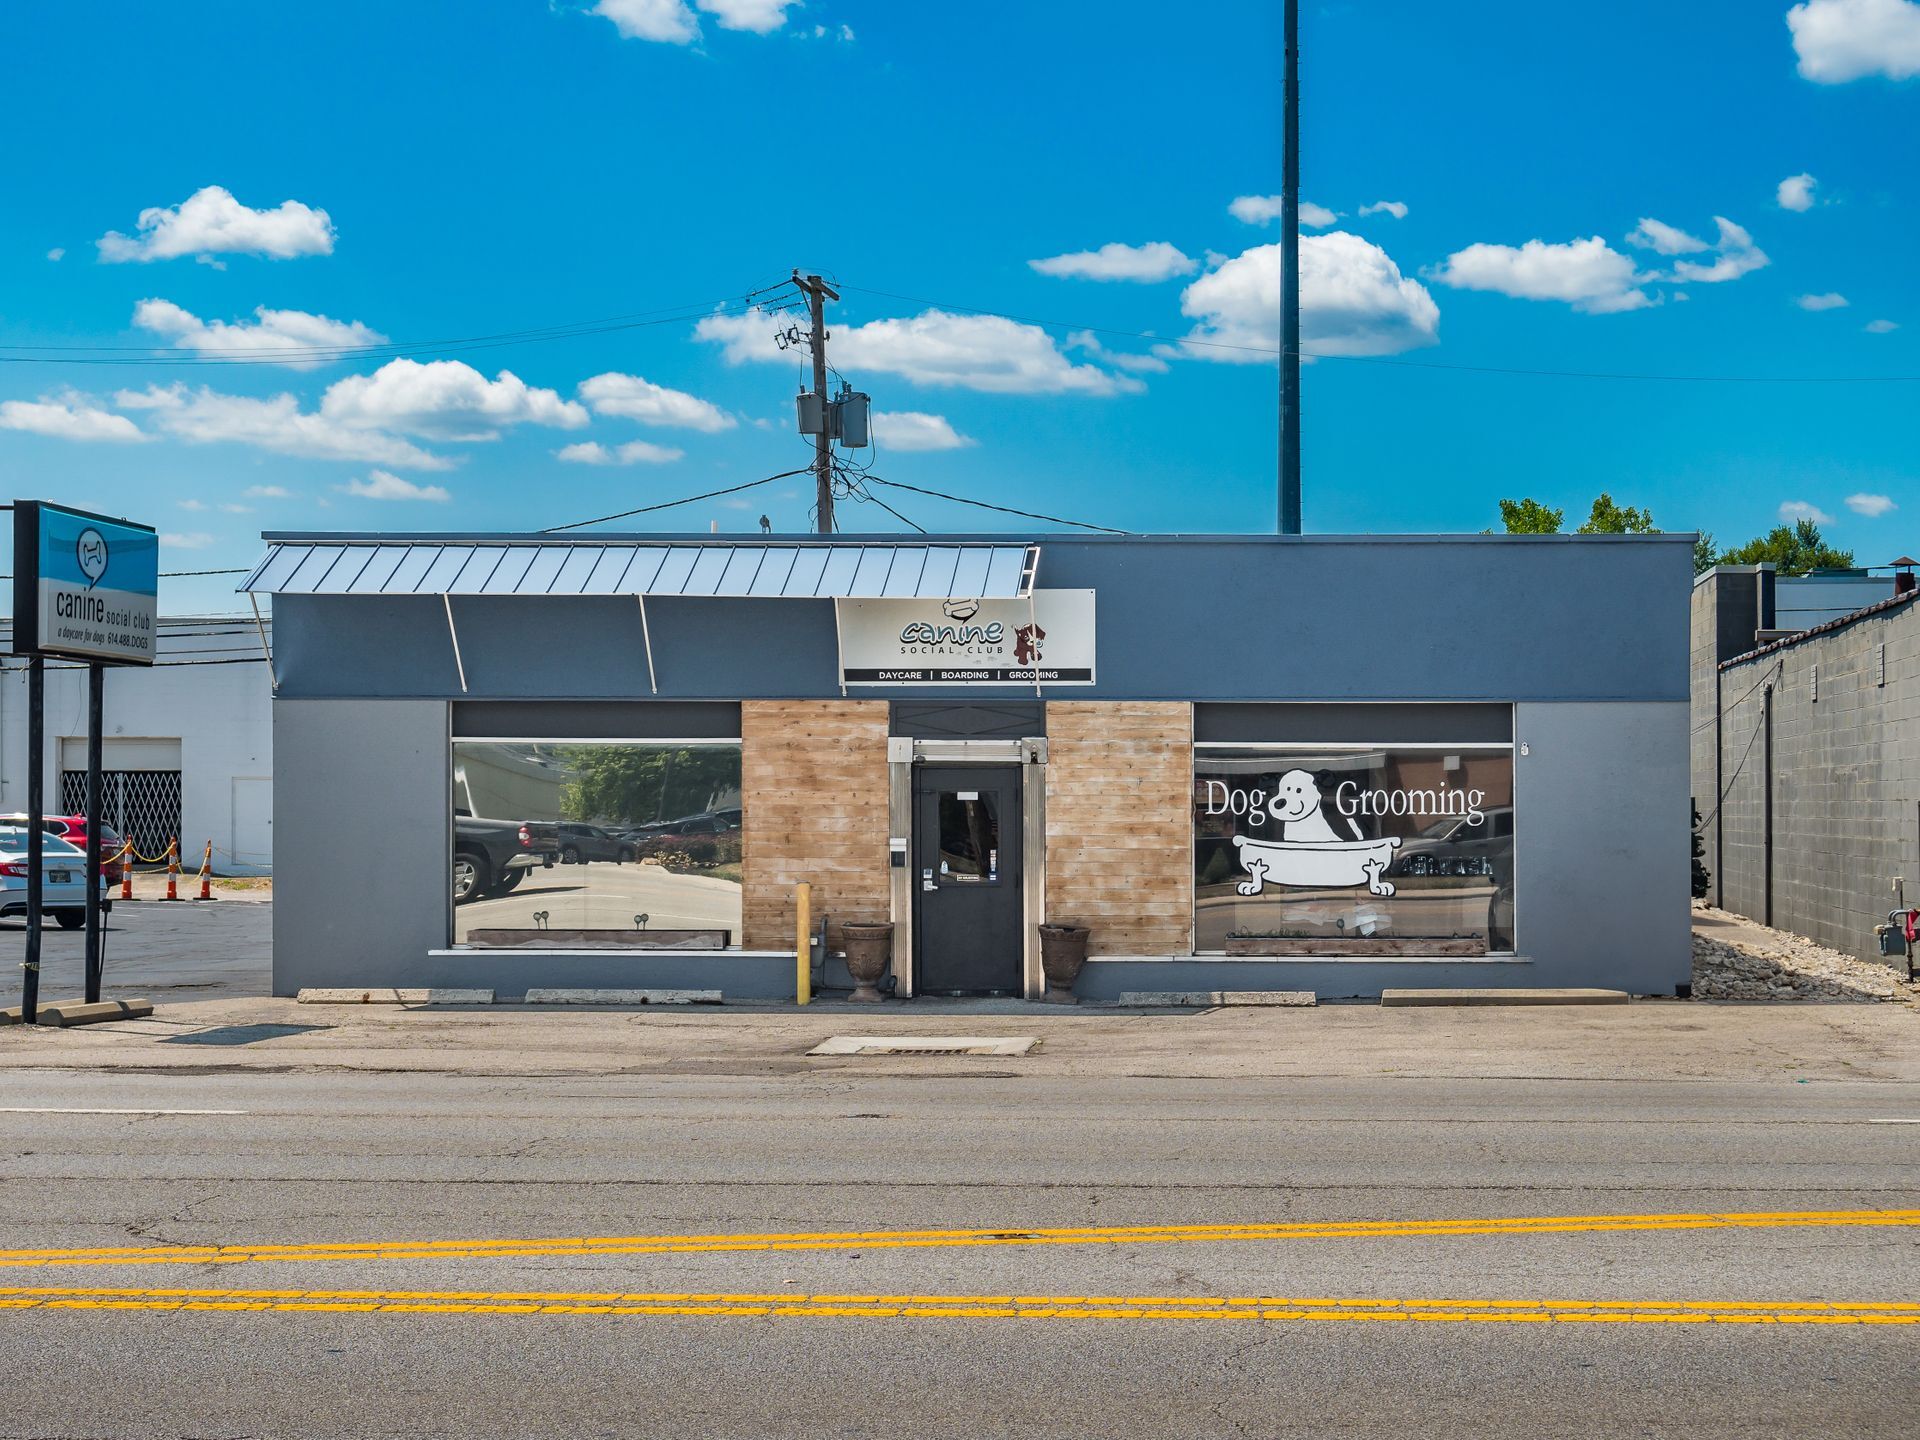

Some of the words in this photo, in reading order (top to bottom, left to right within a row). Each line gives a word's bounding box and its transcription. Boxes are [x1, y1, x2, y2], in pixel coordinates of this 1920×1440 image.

[57, 587, 104, 623] canine
[106, 609, 131, 627] social
[133, 610, 150, 630] club
[57, 627, 62, 638] a
[62, 626, 84, 641] daycare
[83, 628, 93, 643] for
[93, 630, 105, 645] dogs
[107, 632, 148, 649] 614.488.DOGS
[900, 621, 1004, 646] canine
[900, 646, 954, 654] SOCIAL
[967, 646, 1003, 654] CLUB
[879, 671, 922, 679] DAYCARE
[941, 671, 989, 679] BOARDING
[1205, 780, 1267, 826] Dog
[1335, 780, 1486, 827] Grooming
